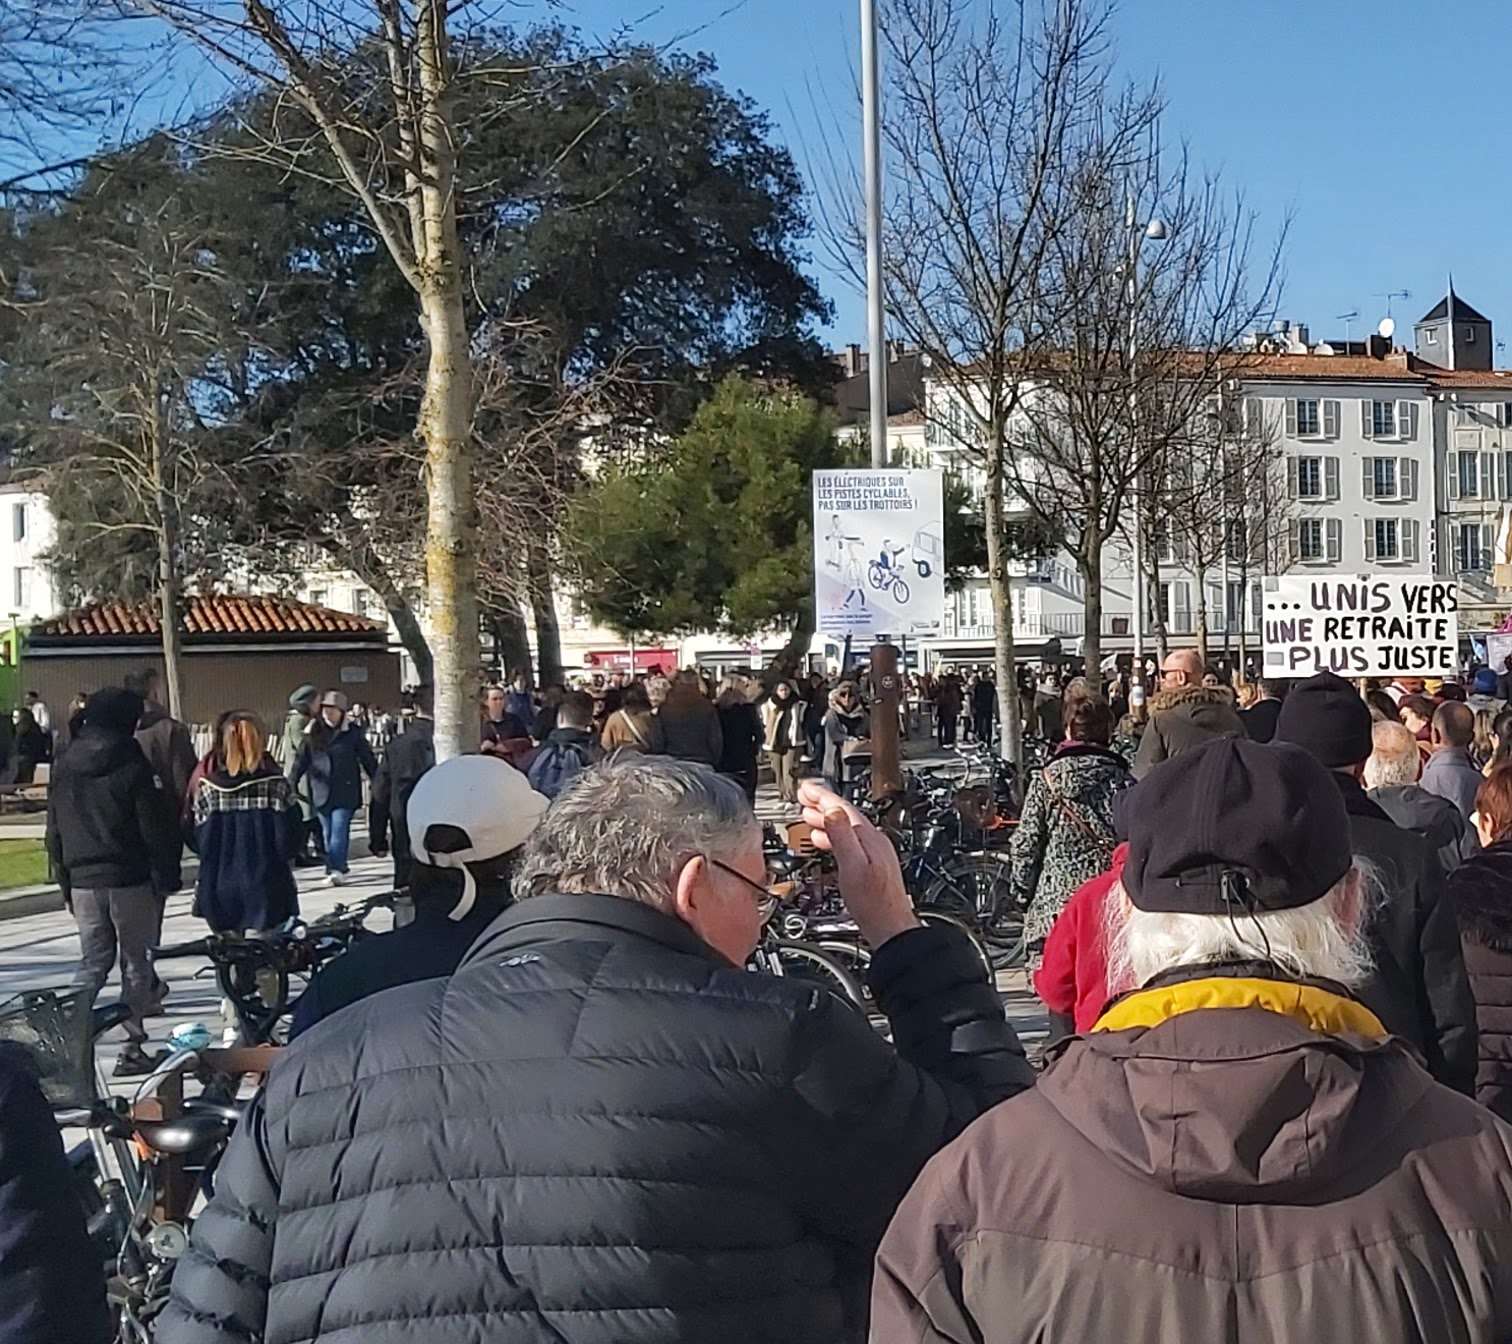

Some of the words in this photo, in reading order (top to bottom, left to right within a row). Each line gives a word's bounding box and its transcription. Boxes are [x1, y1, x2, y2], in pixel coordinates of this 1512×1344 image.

[818, 477, 832, 487] LES
[888, 476, 904, 487] SUR
[818, 489, 832, 499] LES
[834, 489, 861, 499] PISTES
[818, 500, 834, 510] PAS
[835, 500, 852, 510] SUR
[853, 500, 868, 510] LES
[1401, 582, 1459, 614] VERS
[1266, 617, 1314, 645] UNE
[1289, 645, 1370, 673] PLUS
[1377, 645, 1455, 671] JUSTE
